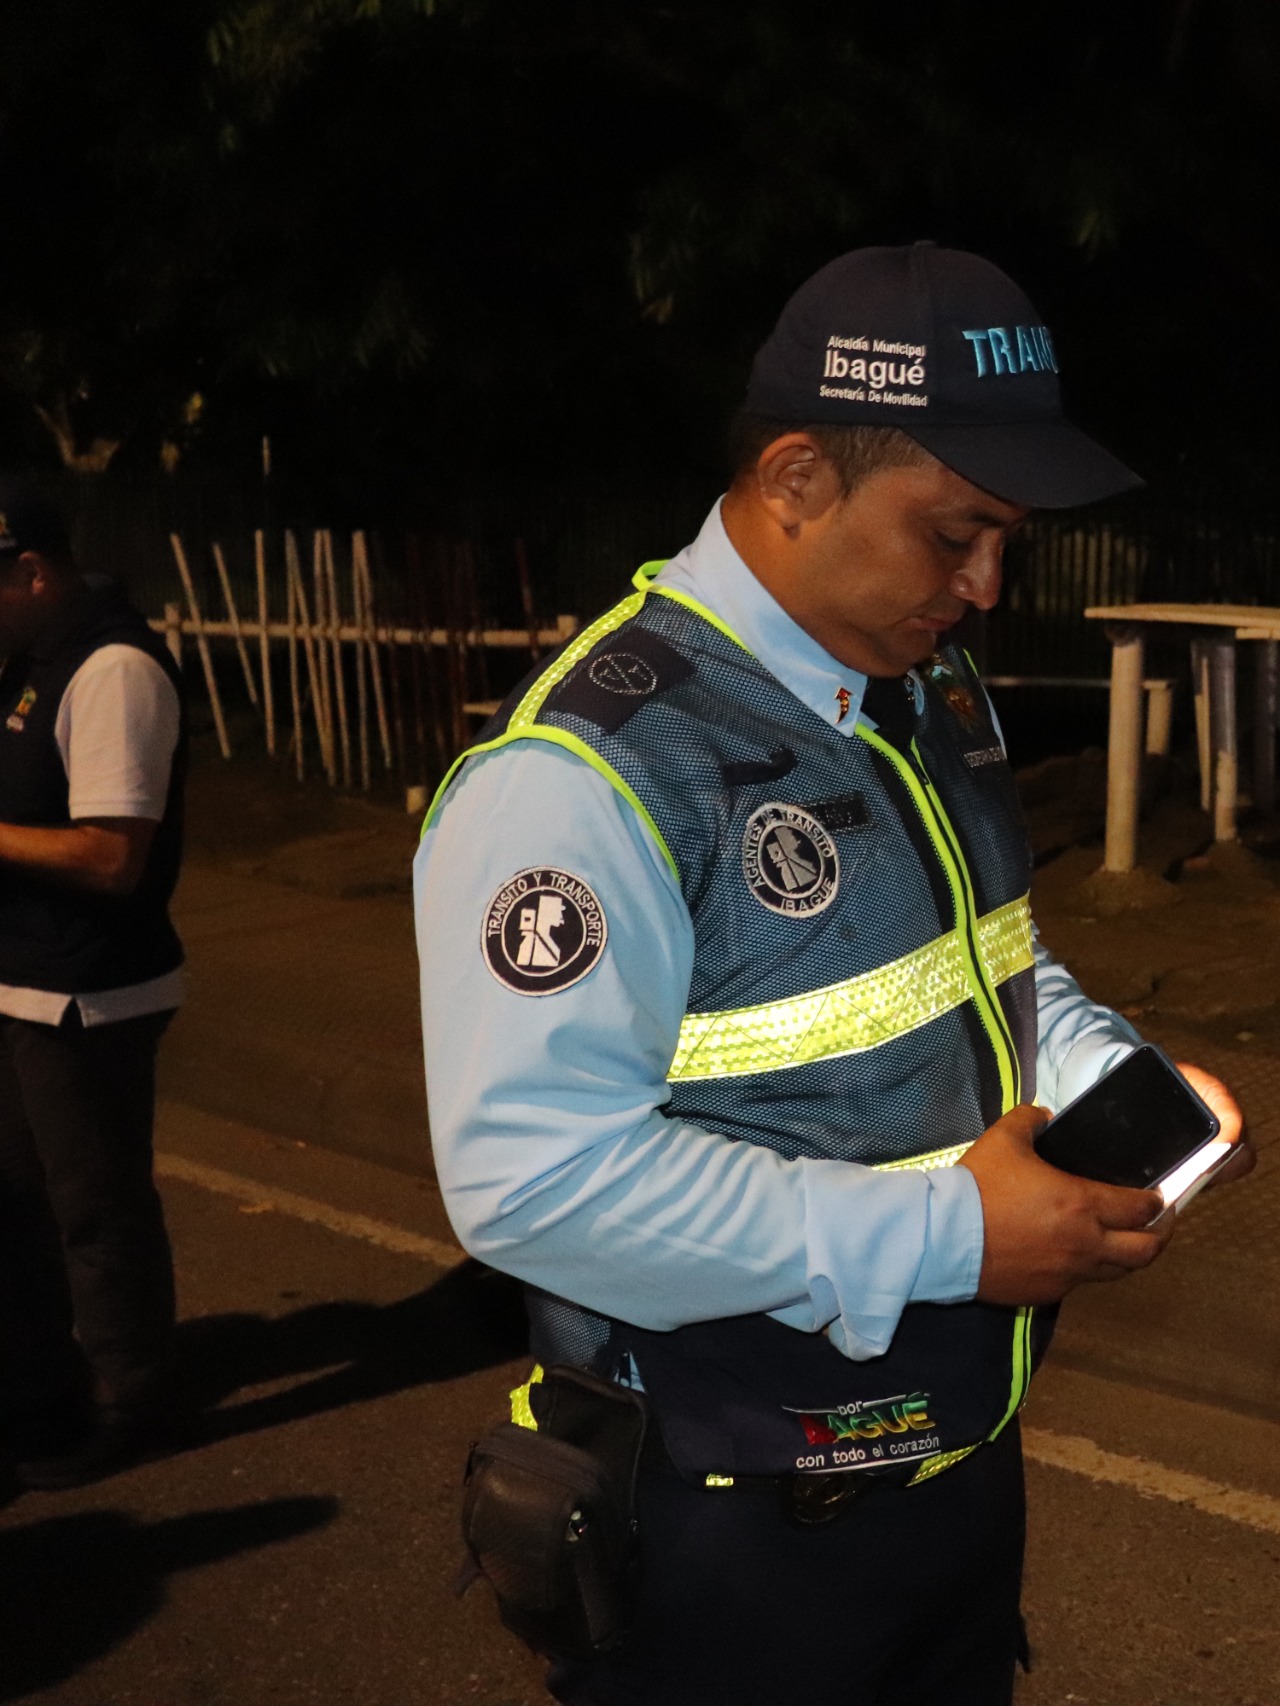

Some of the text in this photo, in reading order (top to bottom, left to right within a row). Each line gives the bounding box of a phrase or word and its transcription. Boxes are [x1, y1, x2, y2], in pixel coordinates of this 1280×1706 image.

[827, 334, 927, 358] Alcaldía Municipal
[823, 349, 926, 390] Ibagué
[819, 384, 929, 407] Secretaría De Movilidad
[488, 873, 601, 947] TRANSITO Y TRANSPORTE
[795, 1432, 940, 1469] con todo el corazón
